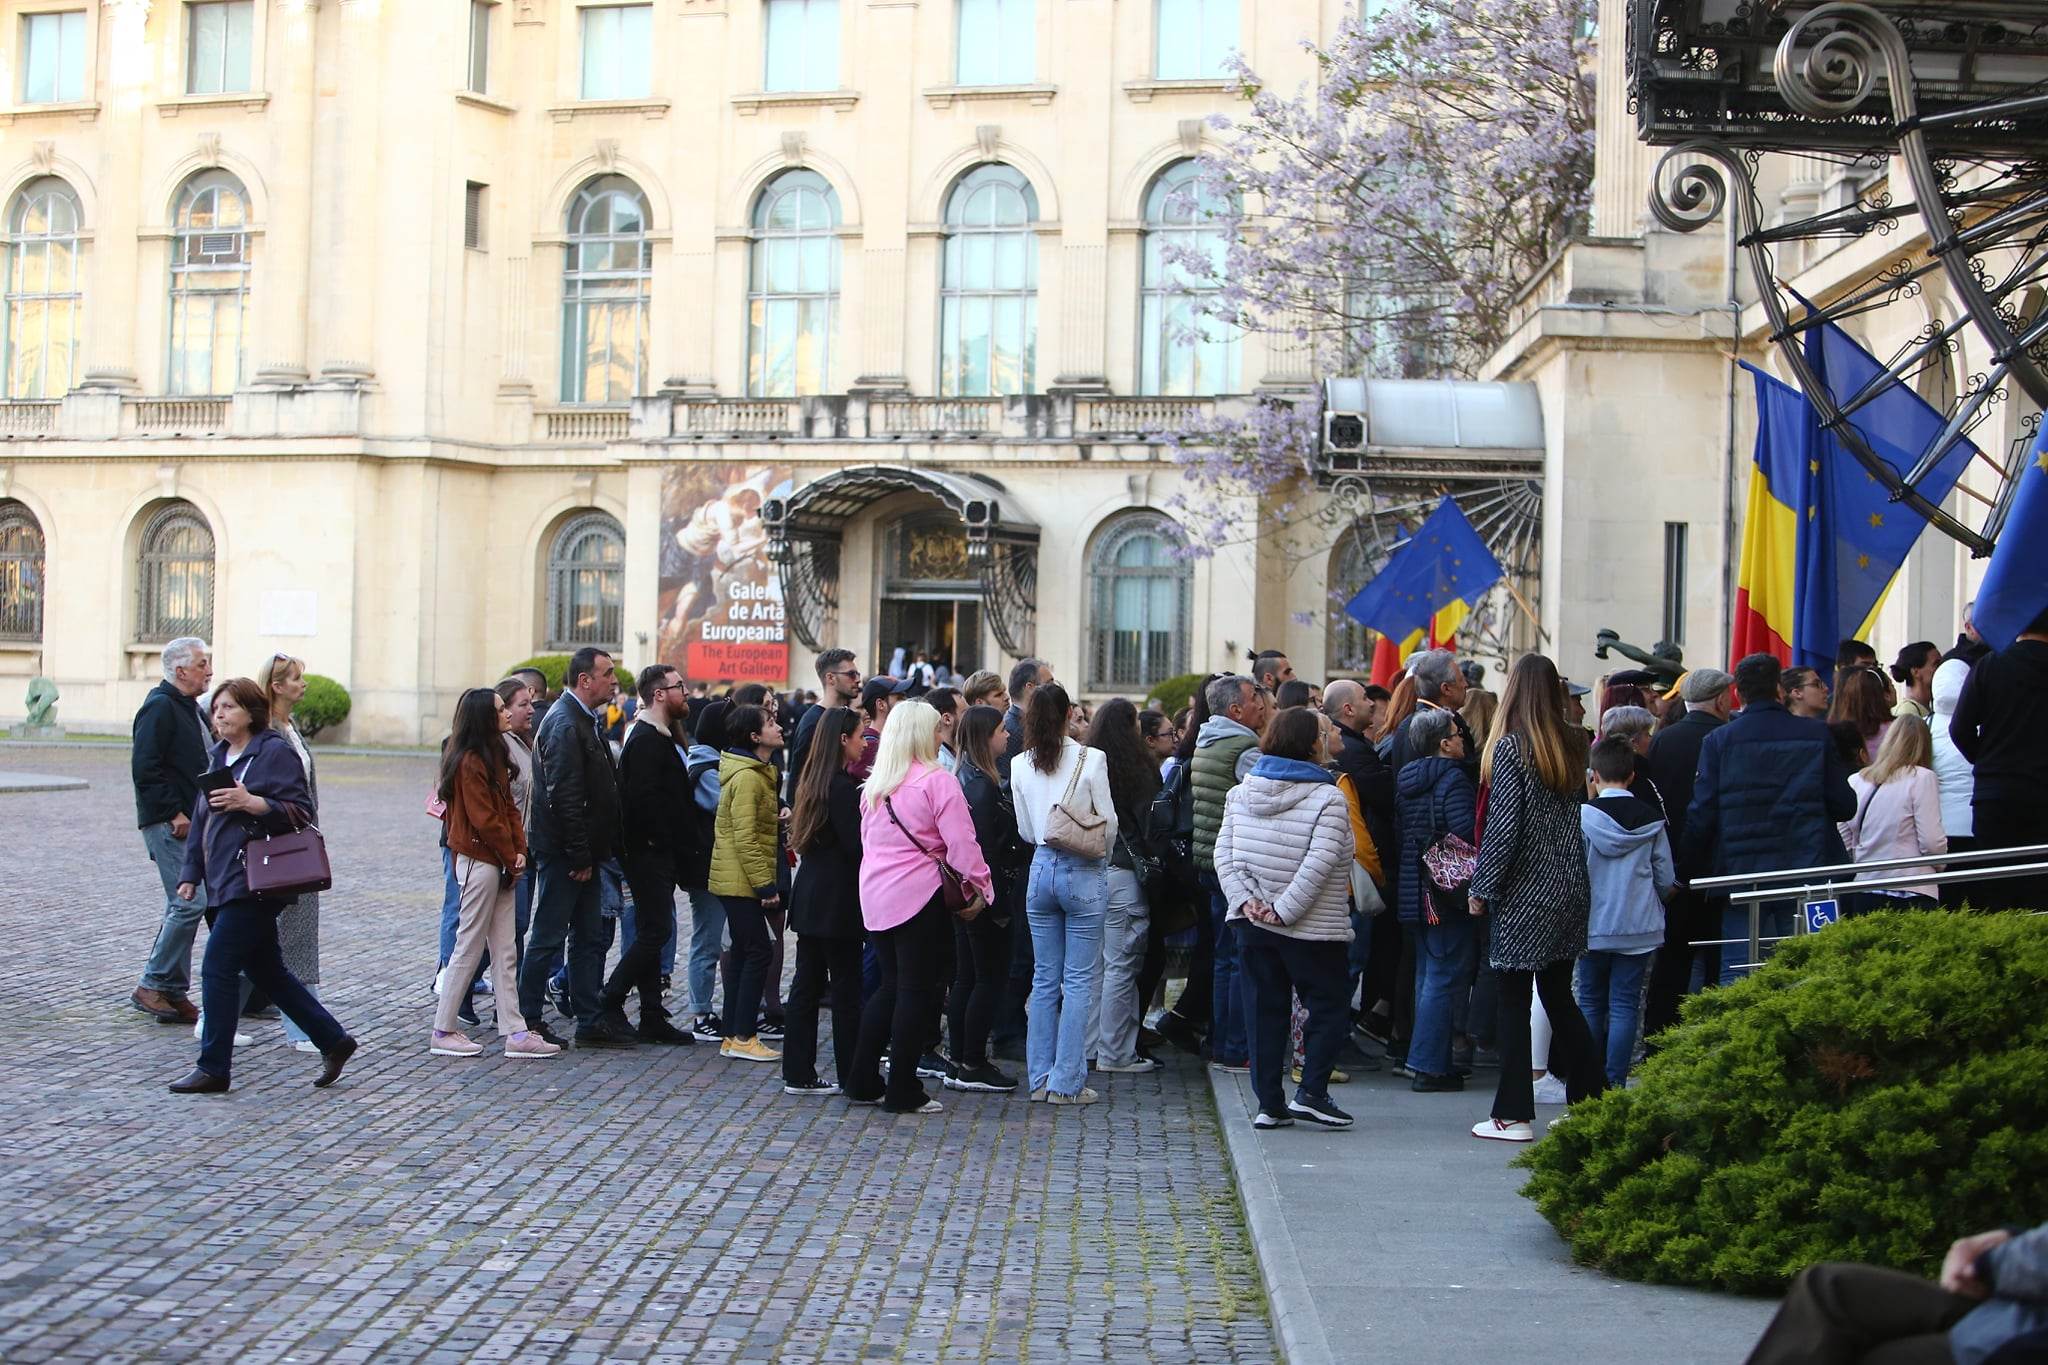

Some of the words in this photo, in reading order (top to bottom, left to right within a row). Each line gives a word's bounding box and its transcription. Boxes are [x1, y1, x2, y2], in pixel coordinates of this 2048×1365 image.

[728, 601, 748, 620] de
[751, 601, 785, 620] Artă
[702, 621, 785, 644] Europeană
[702, 645, 722, 659] The
[726, 646, 783, 662] European
[718, 661, 737, 674] Art
[739, 661, 783, 678] Gallery
